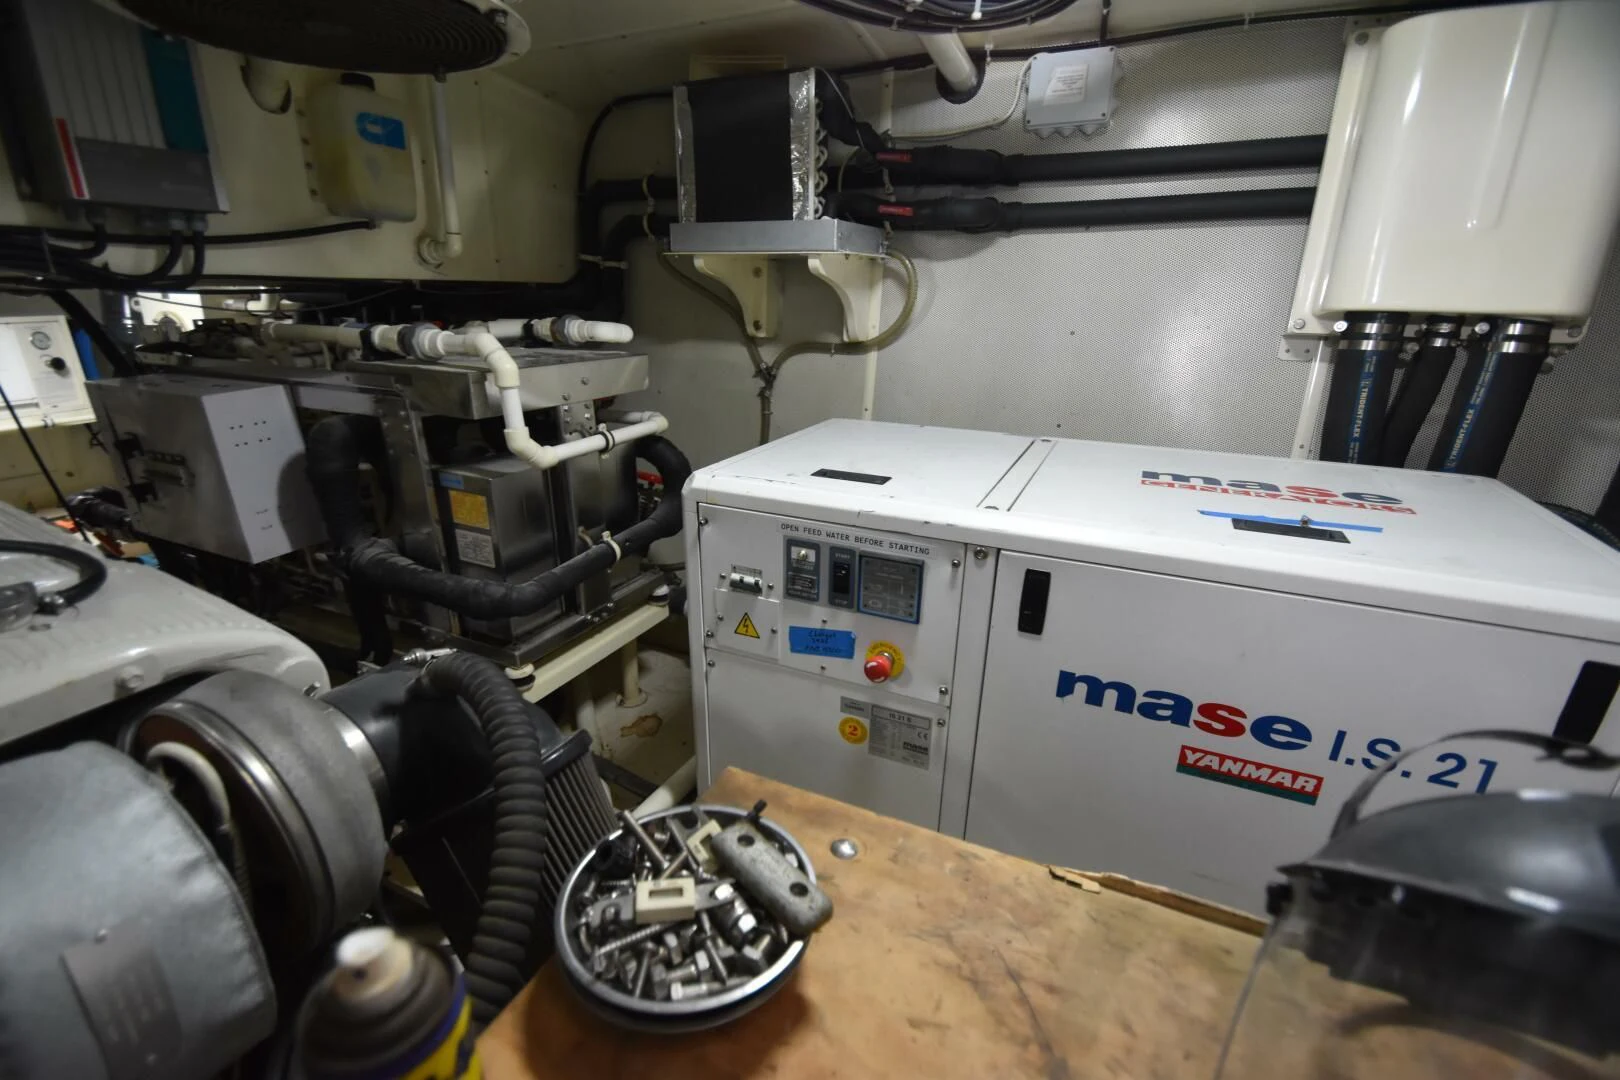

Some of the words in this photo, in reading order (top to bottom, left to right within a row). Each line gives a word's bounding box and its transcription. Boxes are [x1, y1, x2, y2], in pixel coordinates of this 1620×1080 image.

[1142, 470, 1403, 504] mase
[780, 523, 799, 532] OPEN
[803, 527, 822, 536] FEED
[826, 531, 850, 542] WATER
[854, 536, 884, 547] BEFORE
[888, 542, 930, 556] STARTING
[847, 725, 859, 737] 2
[1056, 669, 1313, 751] mase
[1328, 729, 1412, 779] I.S.
[1426, 751, 1498, 794] 21
[1183, 748, 1319, 794] YANMAR
